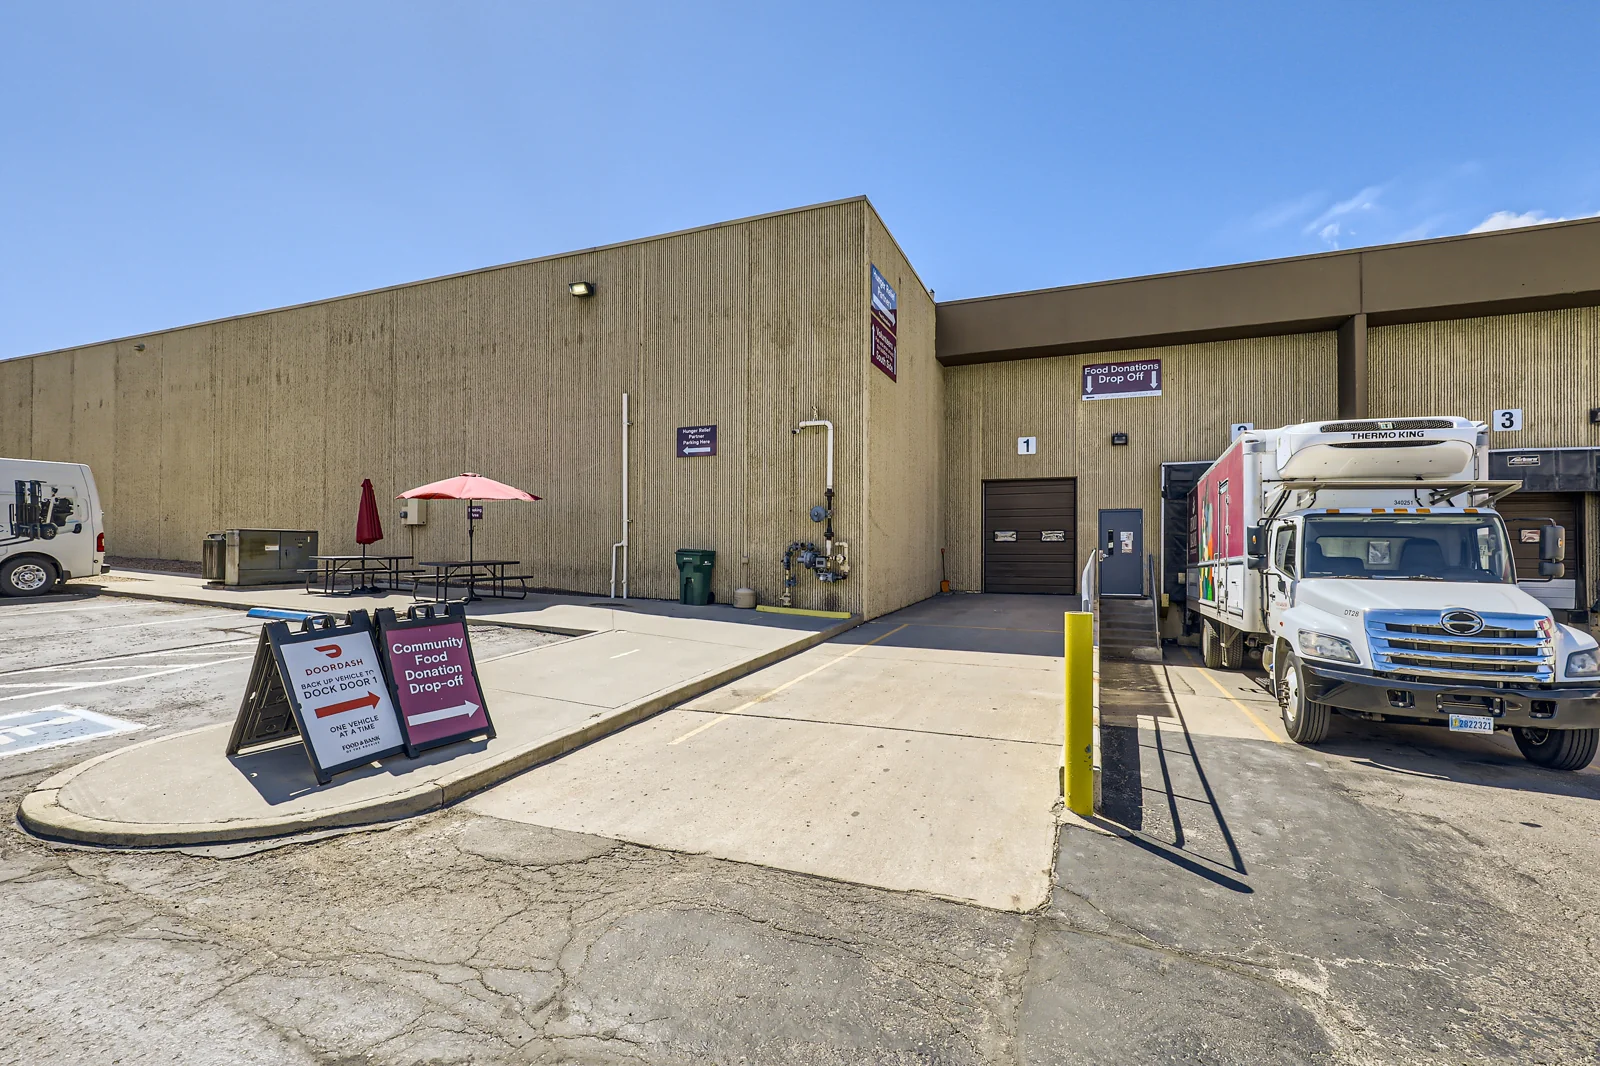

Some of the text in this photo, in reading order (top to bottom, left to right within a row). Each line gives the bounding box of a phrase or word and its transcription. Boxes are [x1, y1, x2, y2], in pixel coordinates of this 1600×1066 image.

[1084, 363, 1159, 375] Food Donations
[1098, 371, 1144, 384] Drop Off
[1501, 411, 1514, 429] 3
[1351, 430, 1424, 440] THERMO KING
[1023, 438, 1030, 453] 1
[392, 637, 464, 654] Community
[414, 651, 448, 666] Food
[305, 658, 364, 676] DOORDASH
[405, 664, 462, 681] Donation
[301, 680, 322, 690] BACK
[323, 677, 333, 685] UP
[335, 671, 364, 682] VEHICLE
[303, 676, 378, 699] DOCK DOOR 1
[409, 674, 464, 695] Drop-off
[330, 714, 379, 733] ONE VEHICLE
[339, 730, 348, 738] AT
[357, 723, 376, 733] TIME
[1459, 719, 1492, 730] 2822321
[342, 735, 381, 751] FOOD BANK
